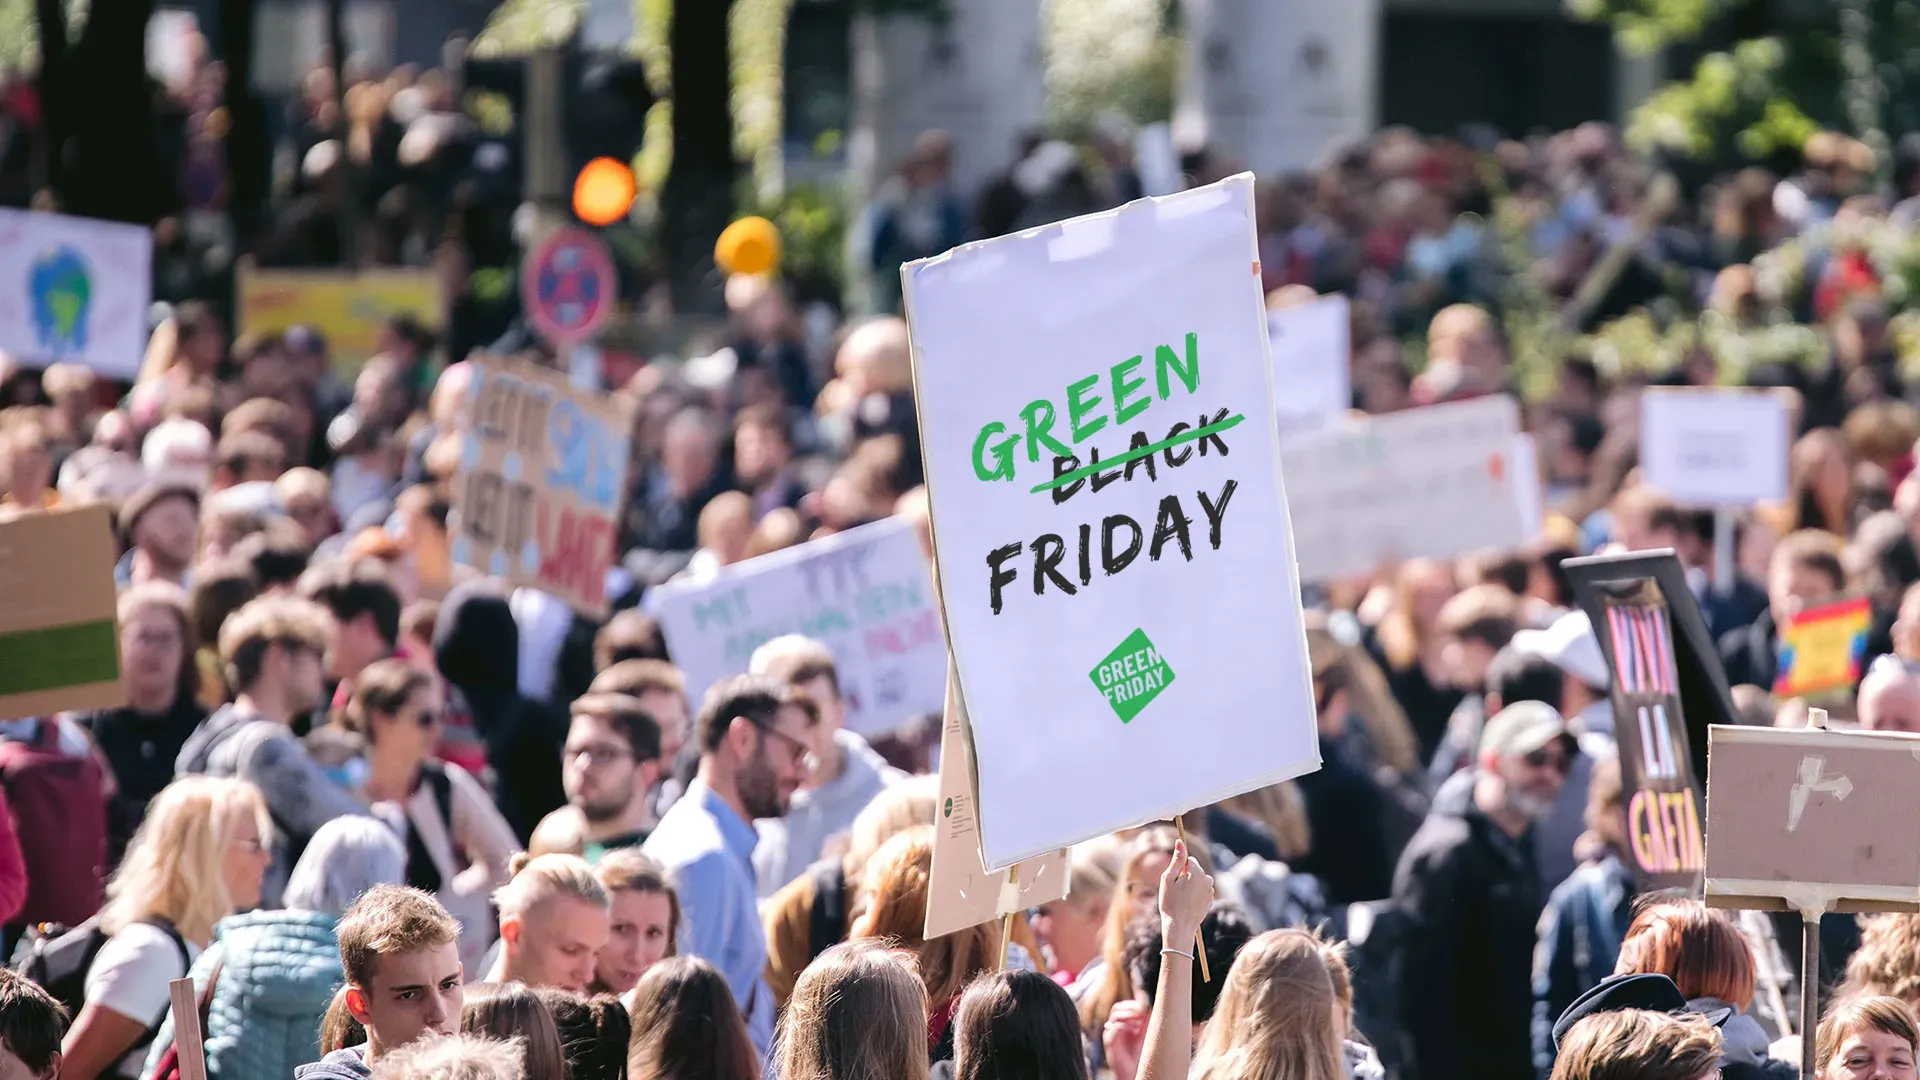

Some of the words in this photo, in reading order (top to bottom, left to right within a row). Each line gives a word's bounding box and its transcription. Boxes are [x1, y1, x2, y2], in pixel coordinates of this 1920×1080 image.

[972, 332, 1200, 482] GREEN
[1051, 407, 1230, 506] BLACK
[986, 479, 1238, 615] FRIDAY
[1098, 646, 1162, 687] GREEN
[1103, 666, 1163, 704] FRIDAY
